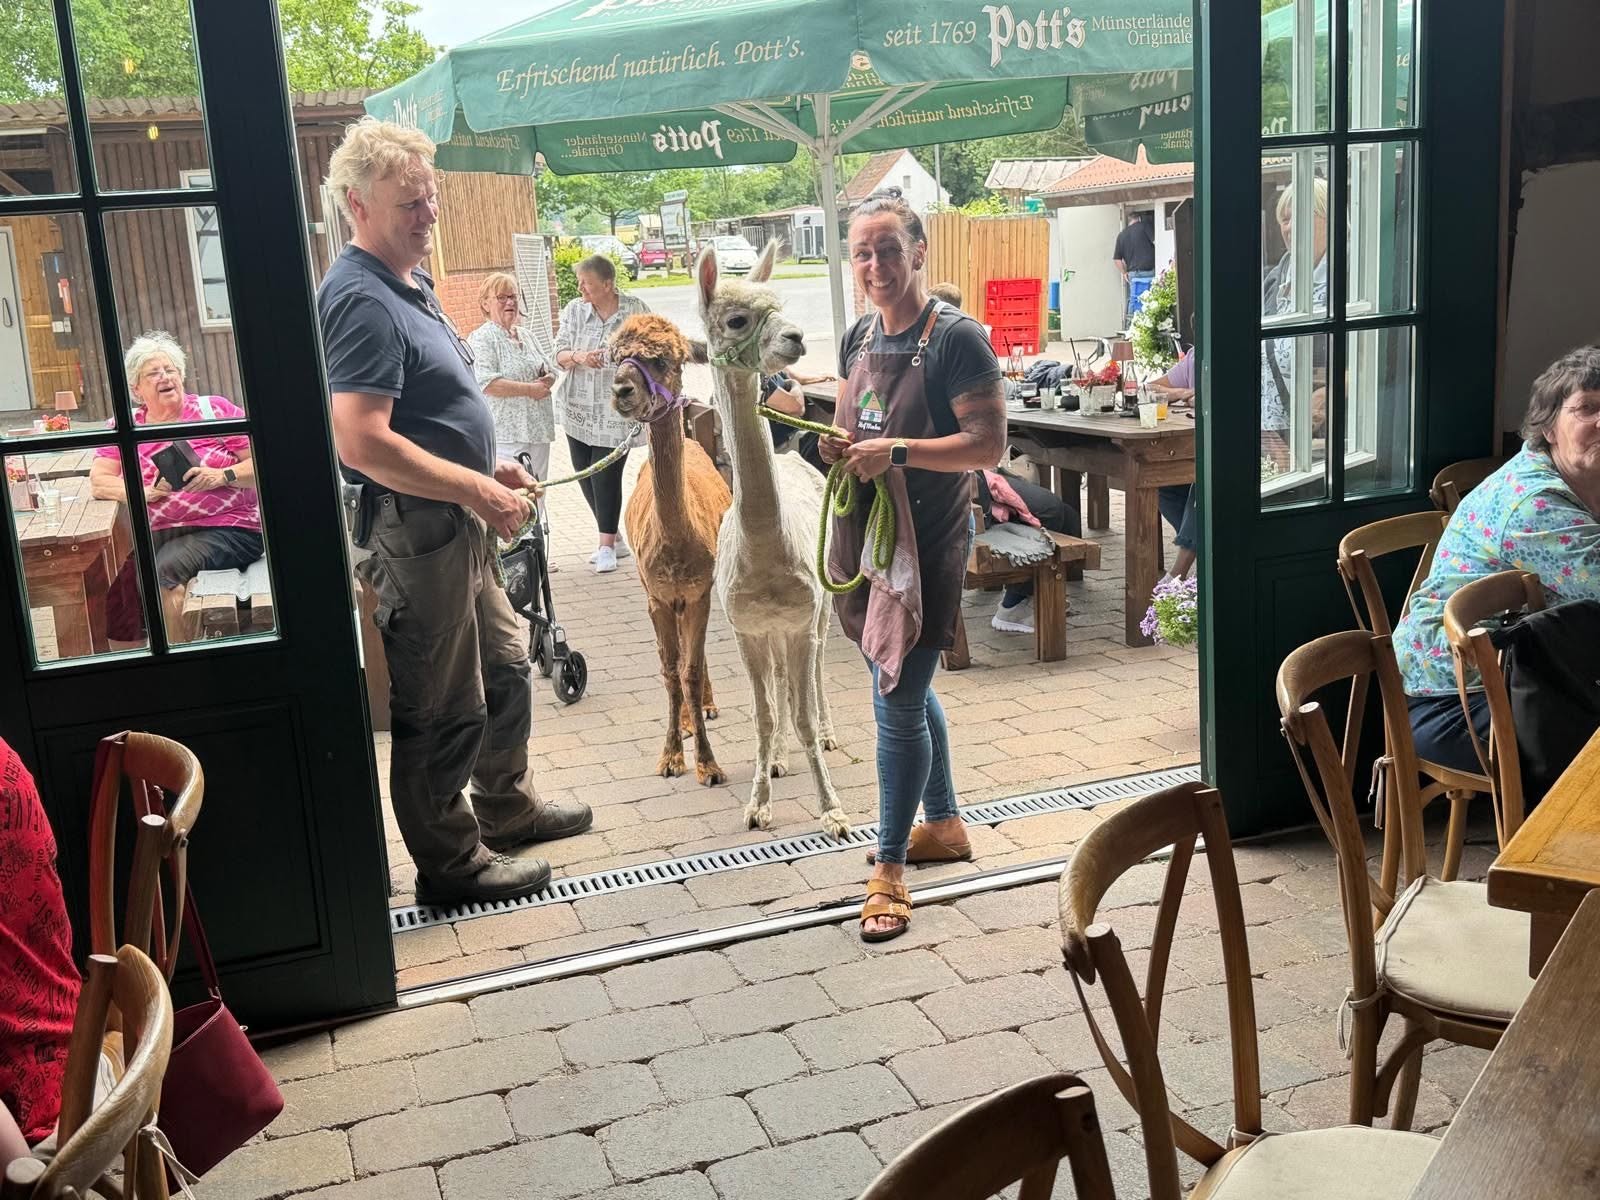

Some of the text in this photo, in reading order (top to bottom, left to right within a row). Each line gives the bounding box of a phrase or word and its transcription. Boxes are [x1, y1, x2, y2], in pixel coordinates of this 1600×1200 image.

[883, 4, 1088, 68] seit 1769 Pott's
[496, 36, 805, 101] Erfrischend natürlich. Pott's.
